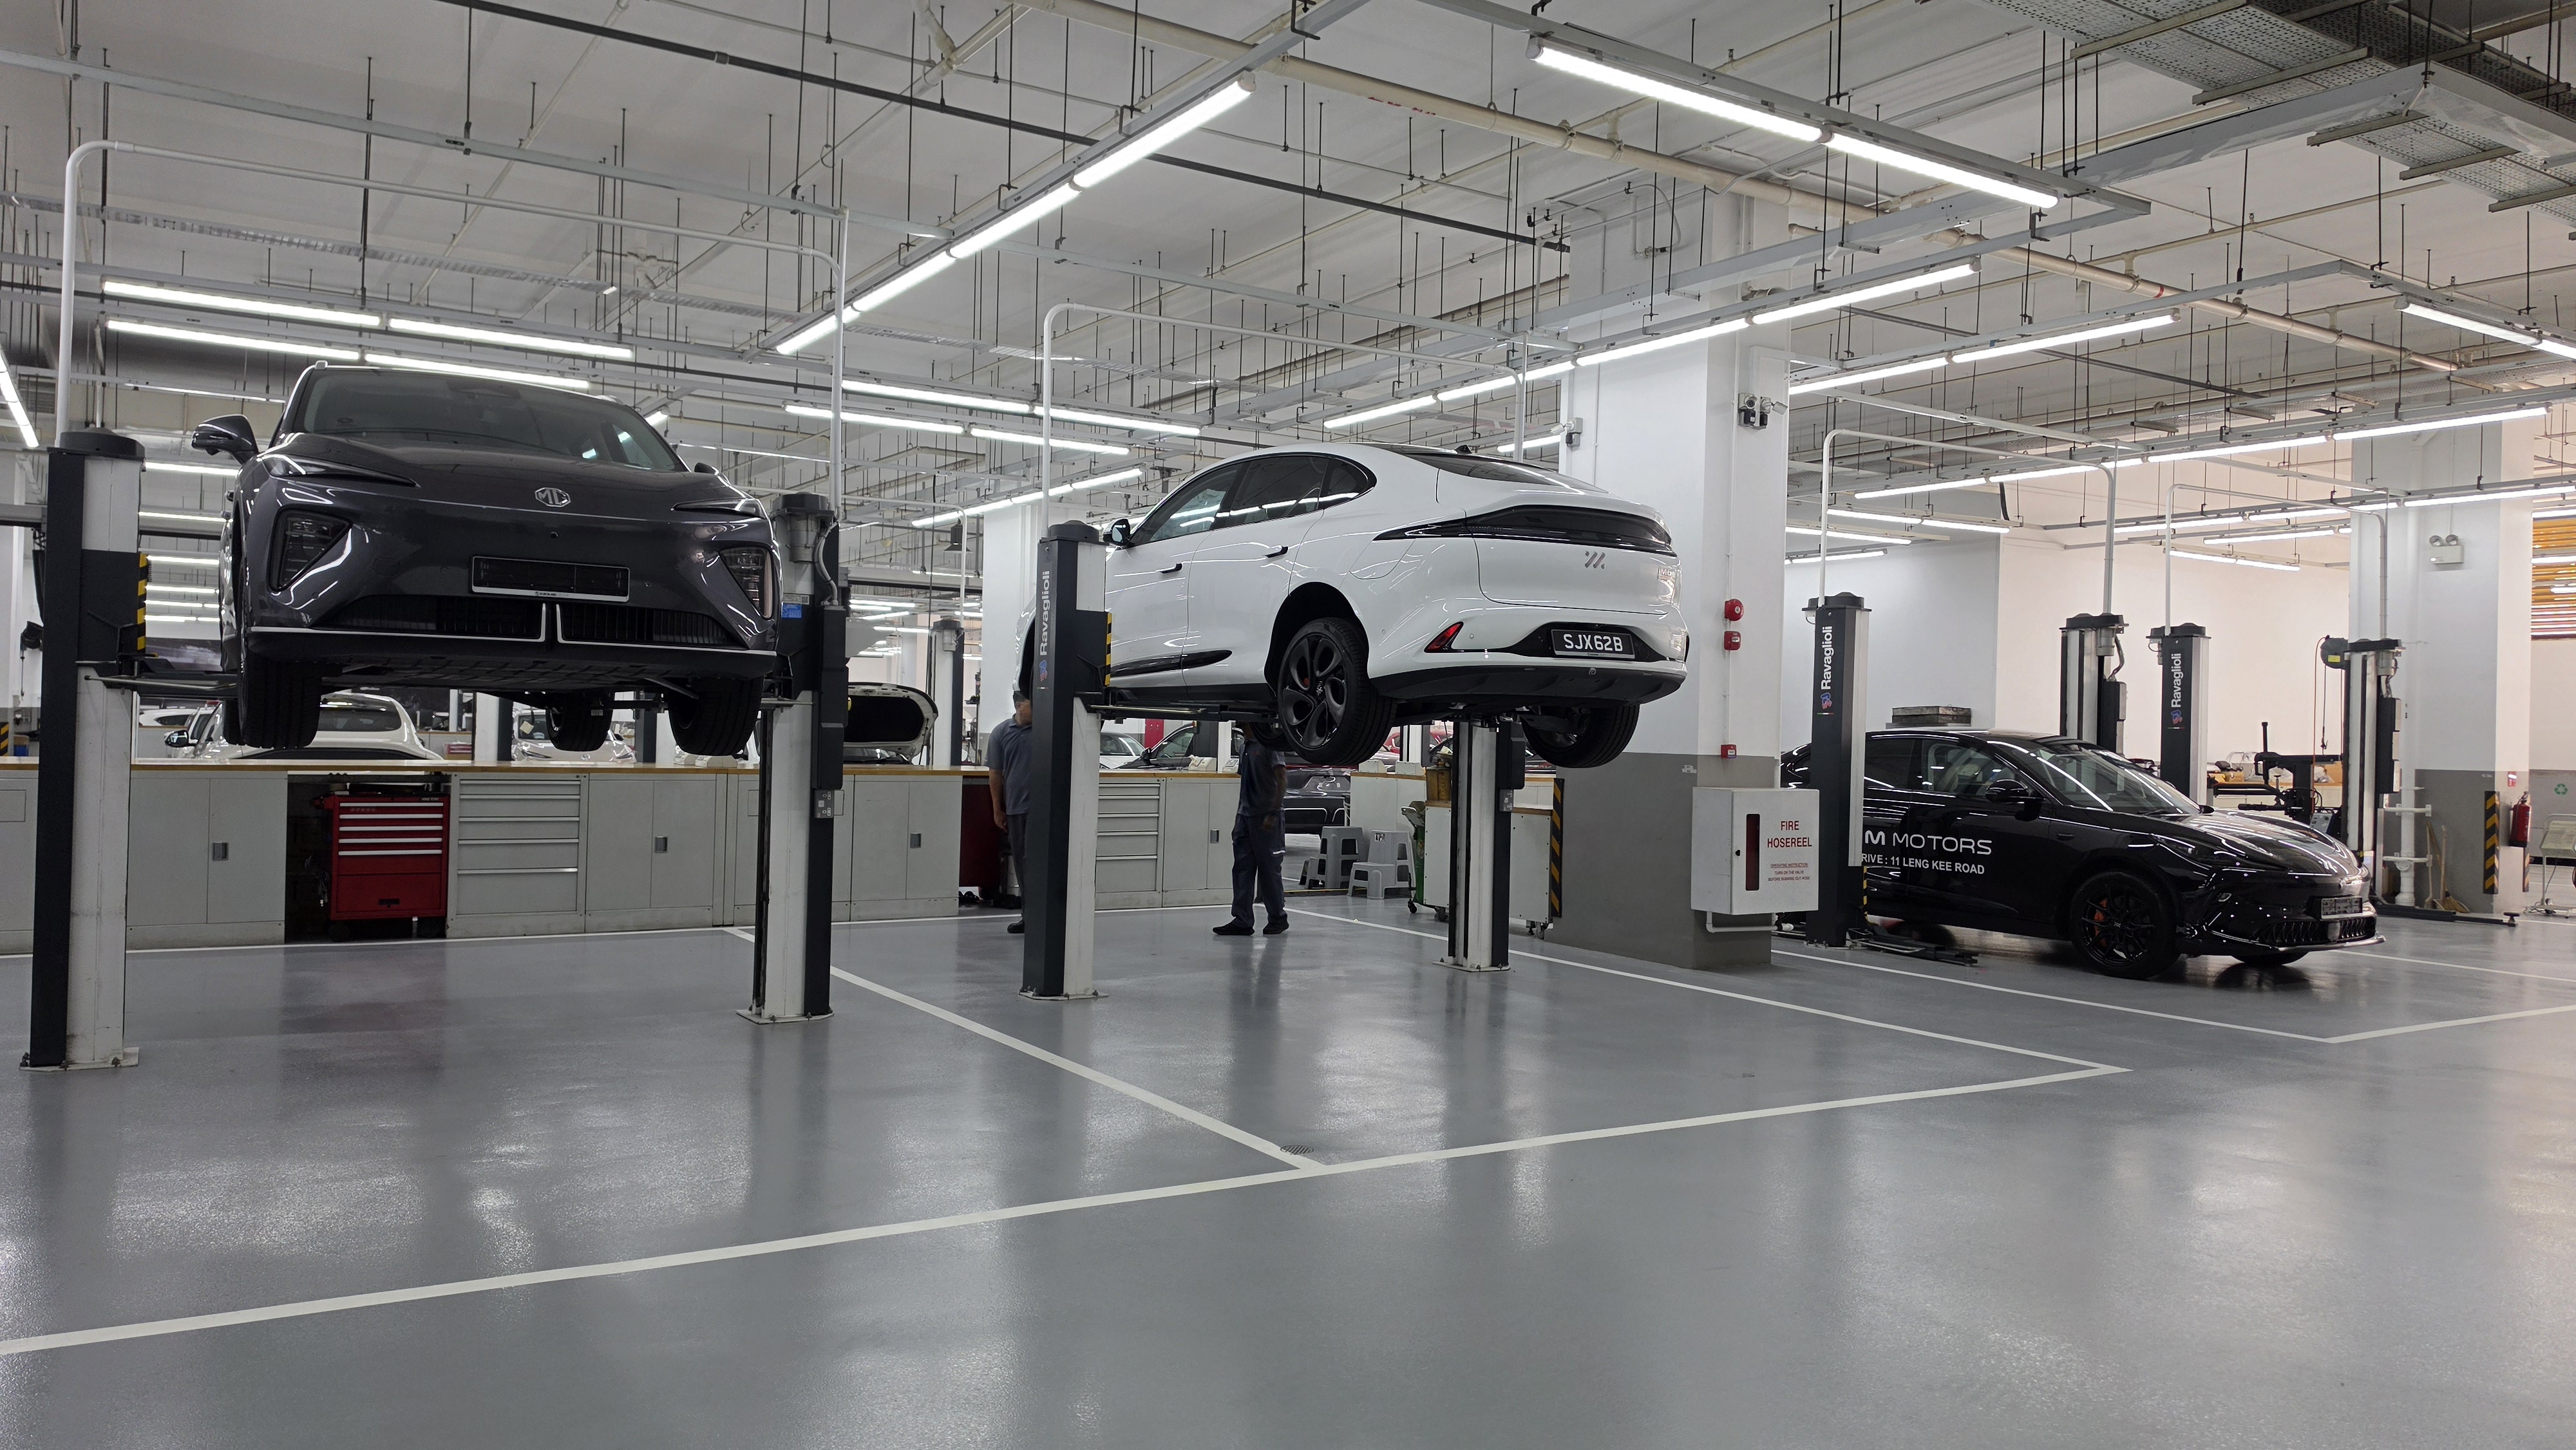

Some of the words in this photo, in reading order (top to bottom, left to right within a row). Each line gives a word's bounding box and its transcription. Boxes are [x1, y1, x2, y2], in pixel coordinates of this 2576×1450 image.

[537, 488, 569, 506] MG
[1040, 570, 1050, 656] Ravaglioli
[1563, 634, 1623, 652] SJX62B
[1821, 626, 1834, 690] Ravaglioli
[2171, 653, 2183, 708] Ravaglioli
[1781, 820, 1799, 831] FIRE
[1767, 837, 1813, 848] HOSEREEL
[1864, 830, 1886, 845] M
[1893, 832, 1992, 855] MOTORS
[1861, 852, 1883, 863] RIVE
[1890, 856, 1899, 865] 11
[1903, 857, 1929, 869] LENG
[1932, 860, 1952, 871] KEE
[1955, 862, 1985, 874] ROAD
